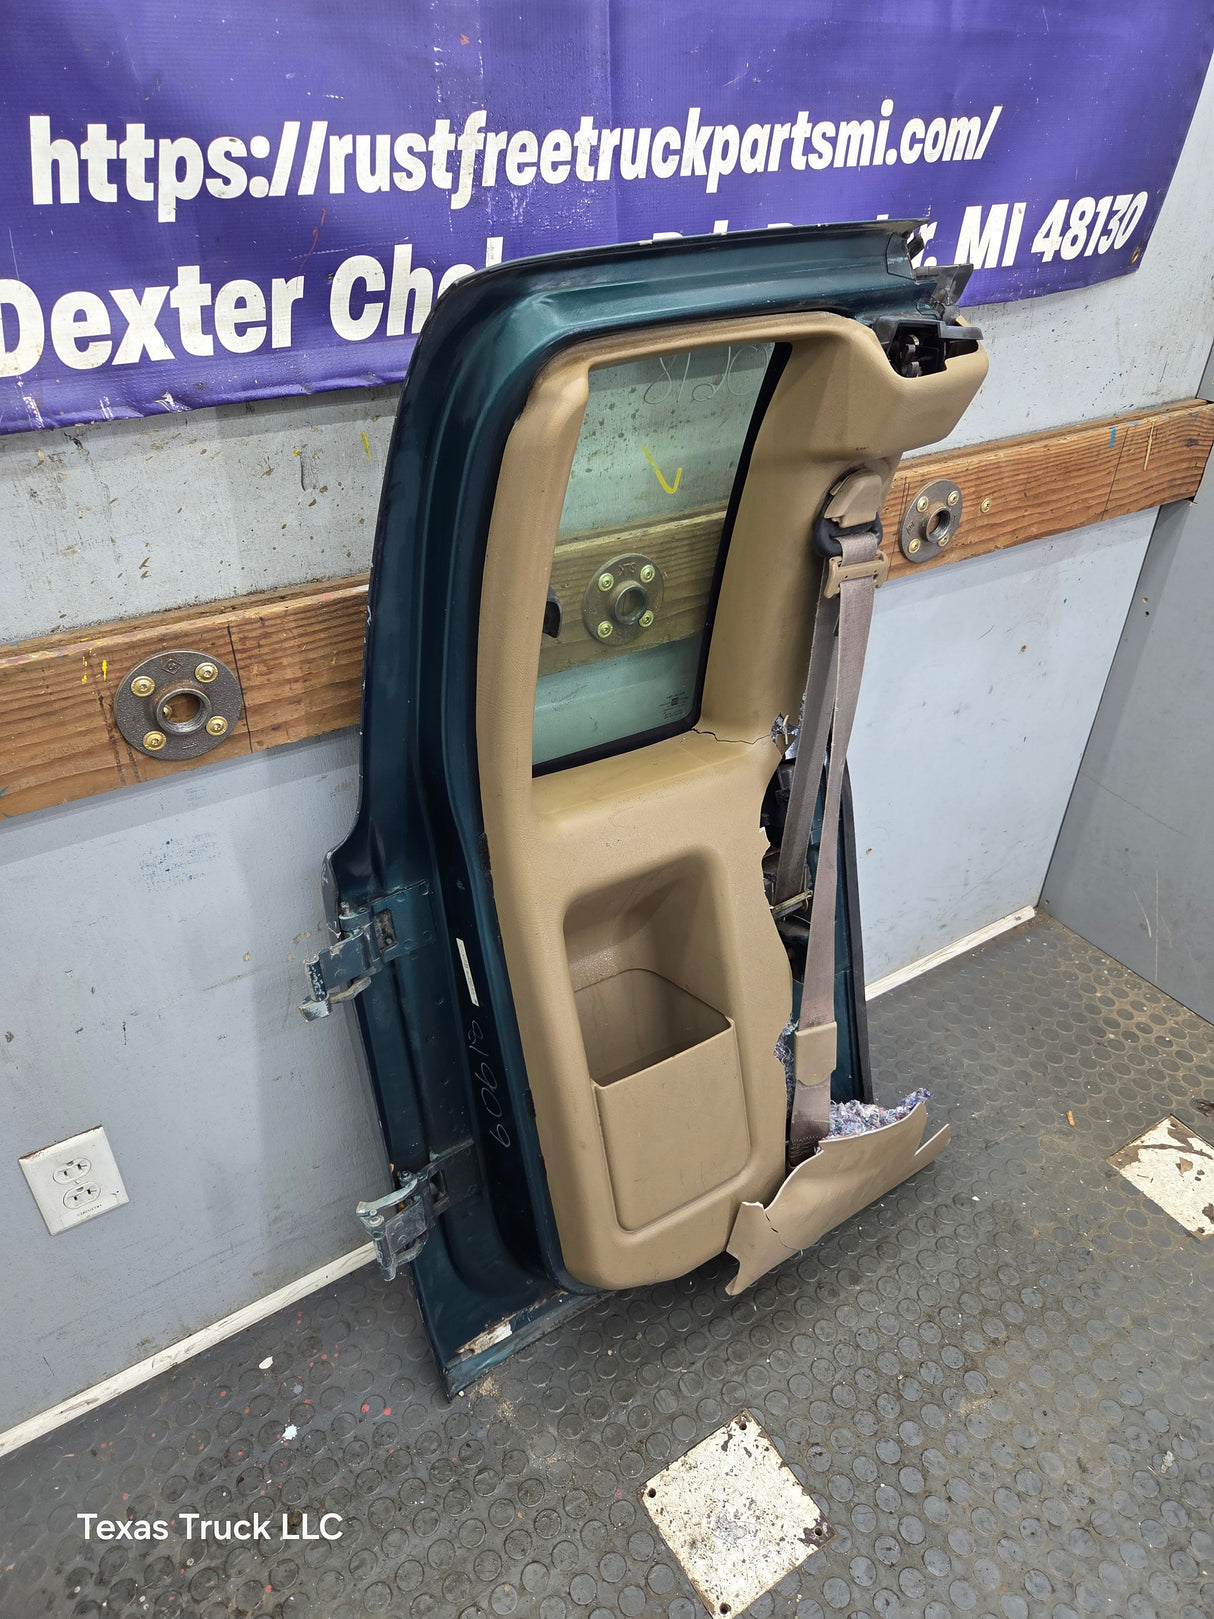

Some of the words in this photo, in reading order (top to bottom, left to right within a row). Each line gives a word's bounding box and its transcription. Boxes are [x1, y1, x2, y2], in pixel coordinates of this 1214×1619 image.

[29, 98, 1003, 224] https://rustfreetruckpartsmi.com/
[954, 201, 1024, 271] MI
[1031, 190, 1148, 263] 48130
